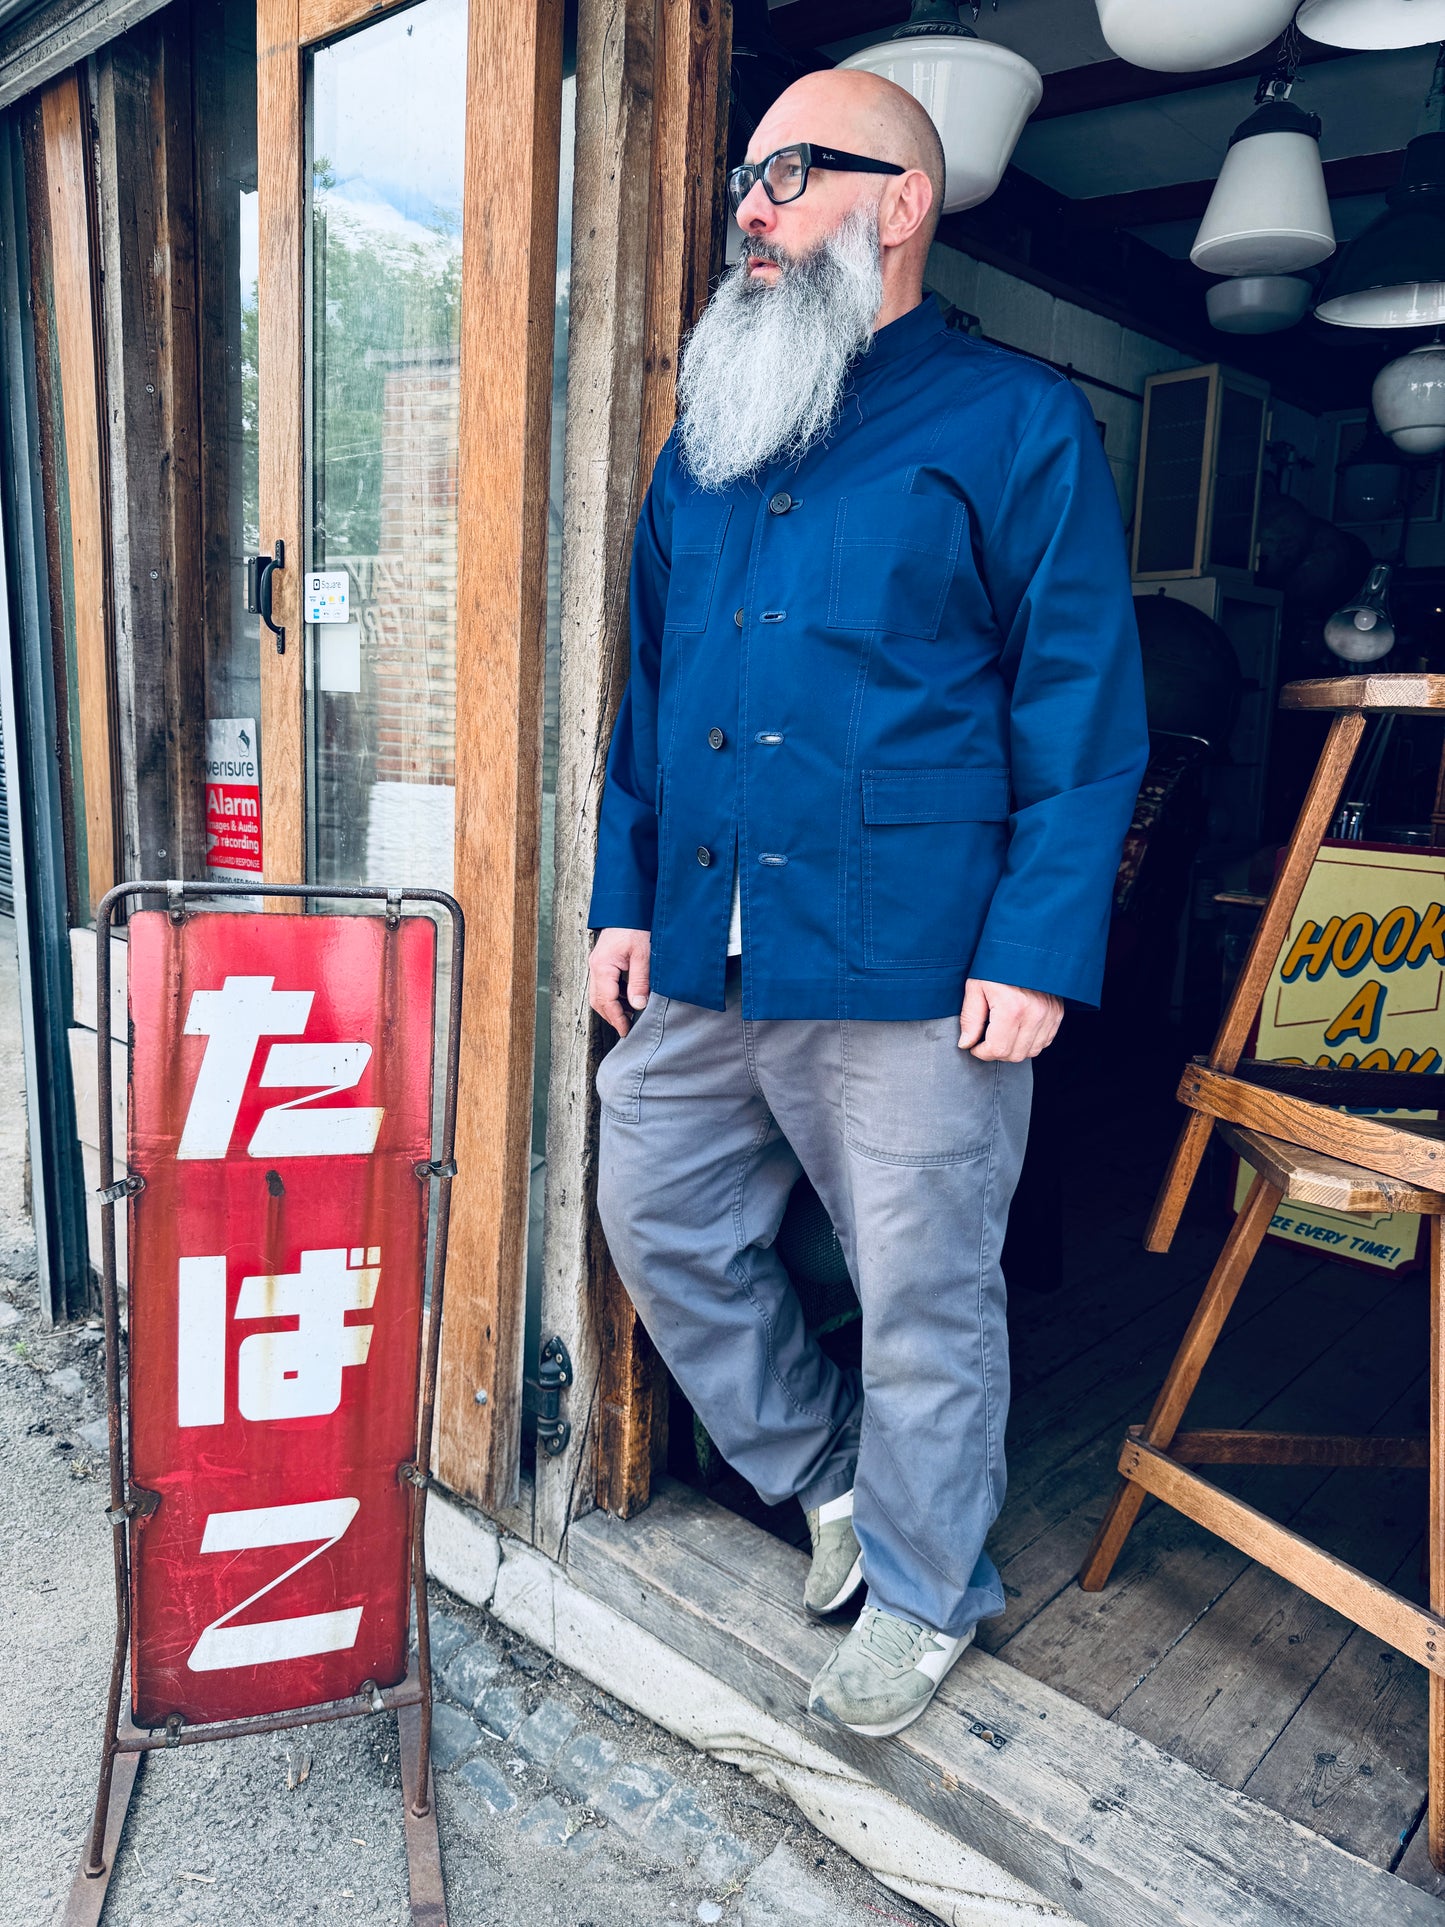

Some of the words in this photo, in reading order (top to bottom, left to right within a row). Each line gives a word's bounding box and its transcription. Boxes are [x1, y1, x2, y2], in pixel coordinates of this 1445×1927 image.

[207, 788, 257, 816] Alarm
[230, 820, 237, 831] &
[239, 821, 258, 834] Audio
[221, 835, 259, 854] recording
[236, 857, 260, 868] RESPONSE
[1280, 902, 1445, 984] HOOK
[1324, 979, 1388, 1047] A
[1294, 1222, 1348, 1244] EVERY
[1349, 1237, 1401, 1262] TIME!
[177, 976, 385, 1673] たばこ
